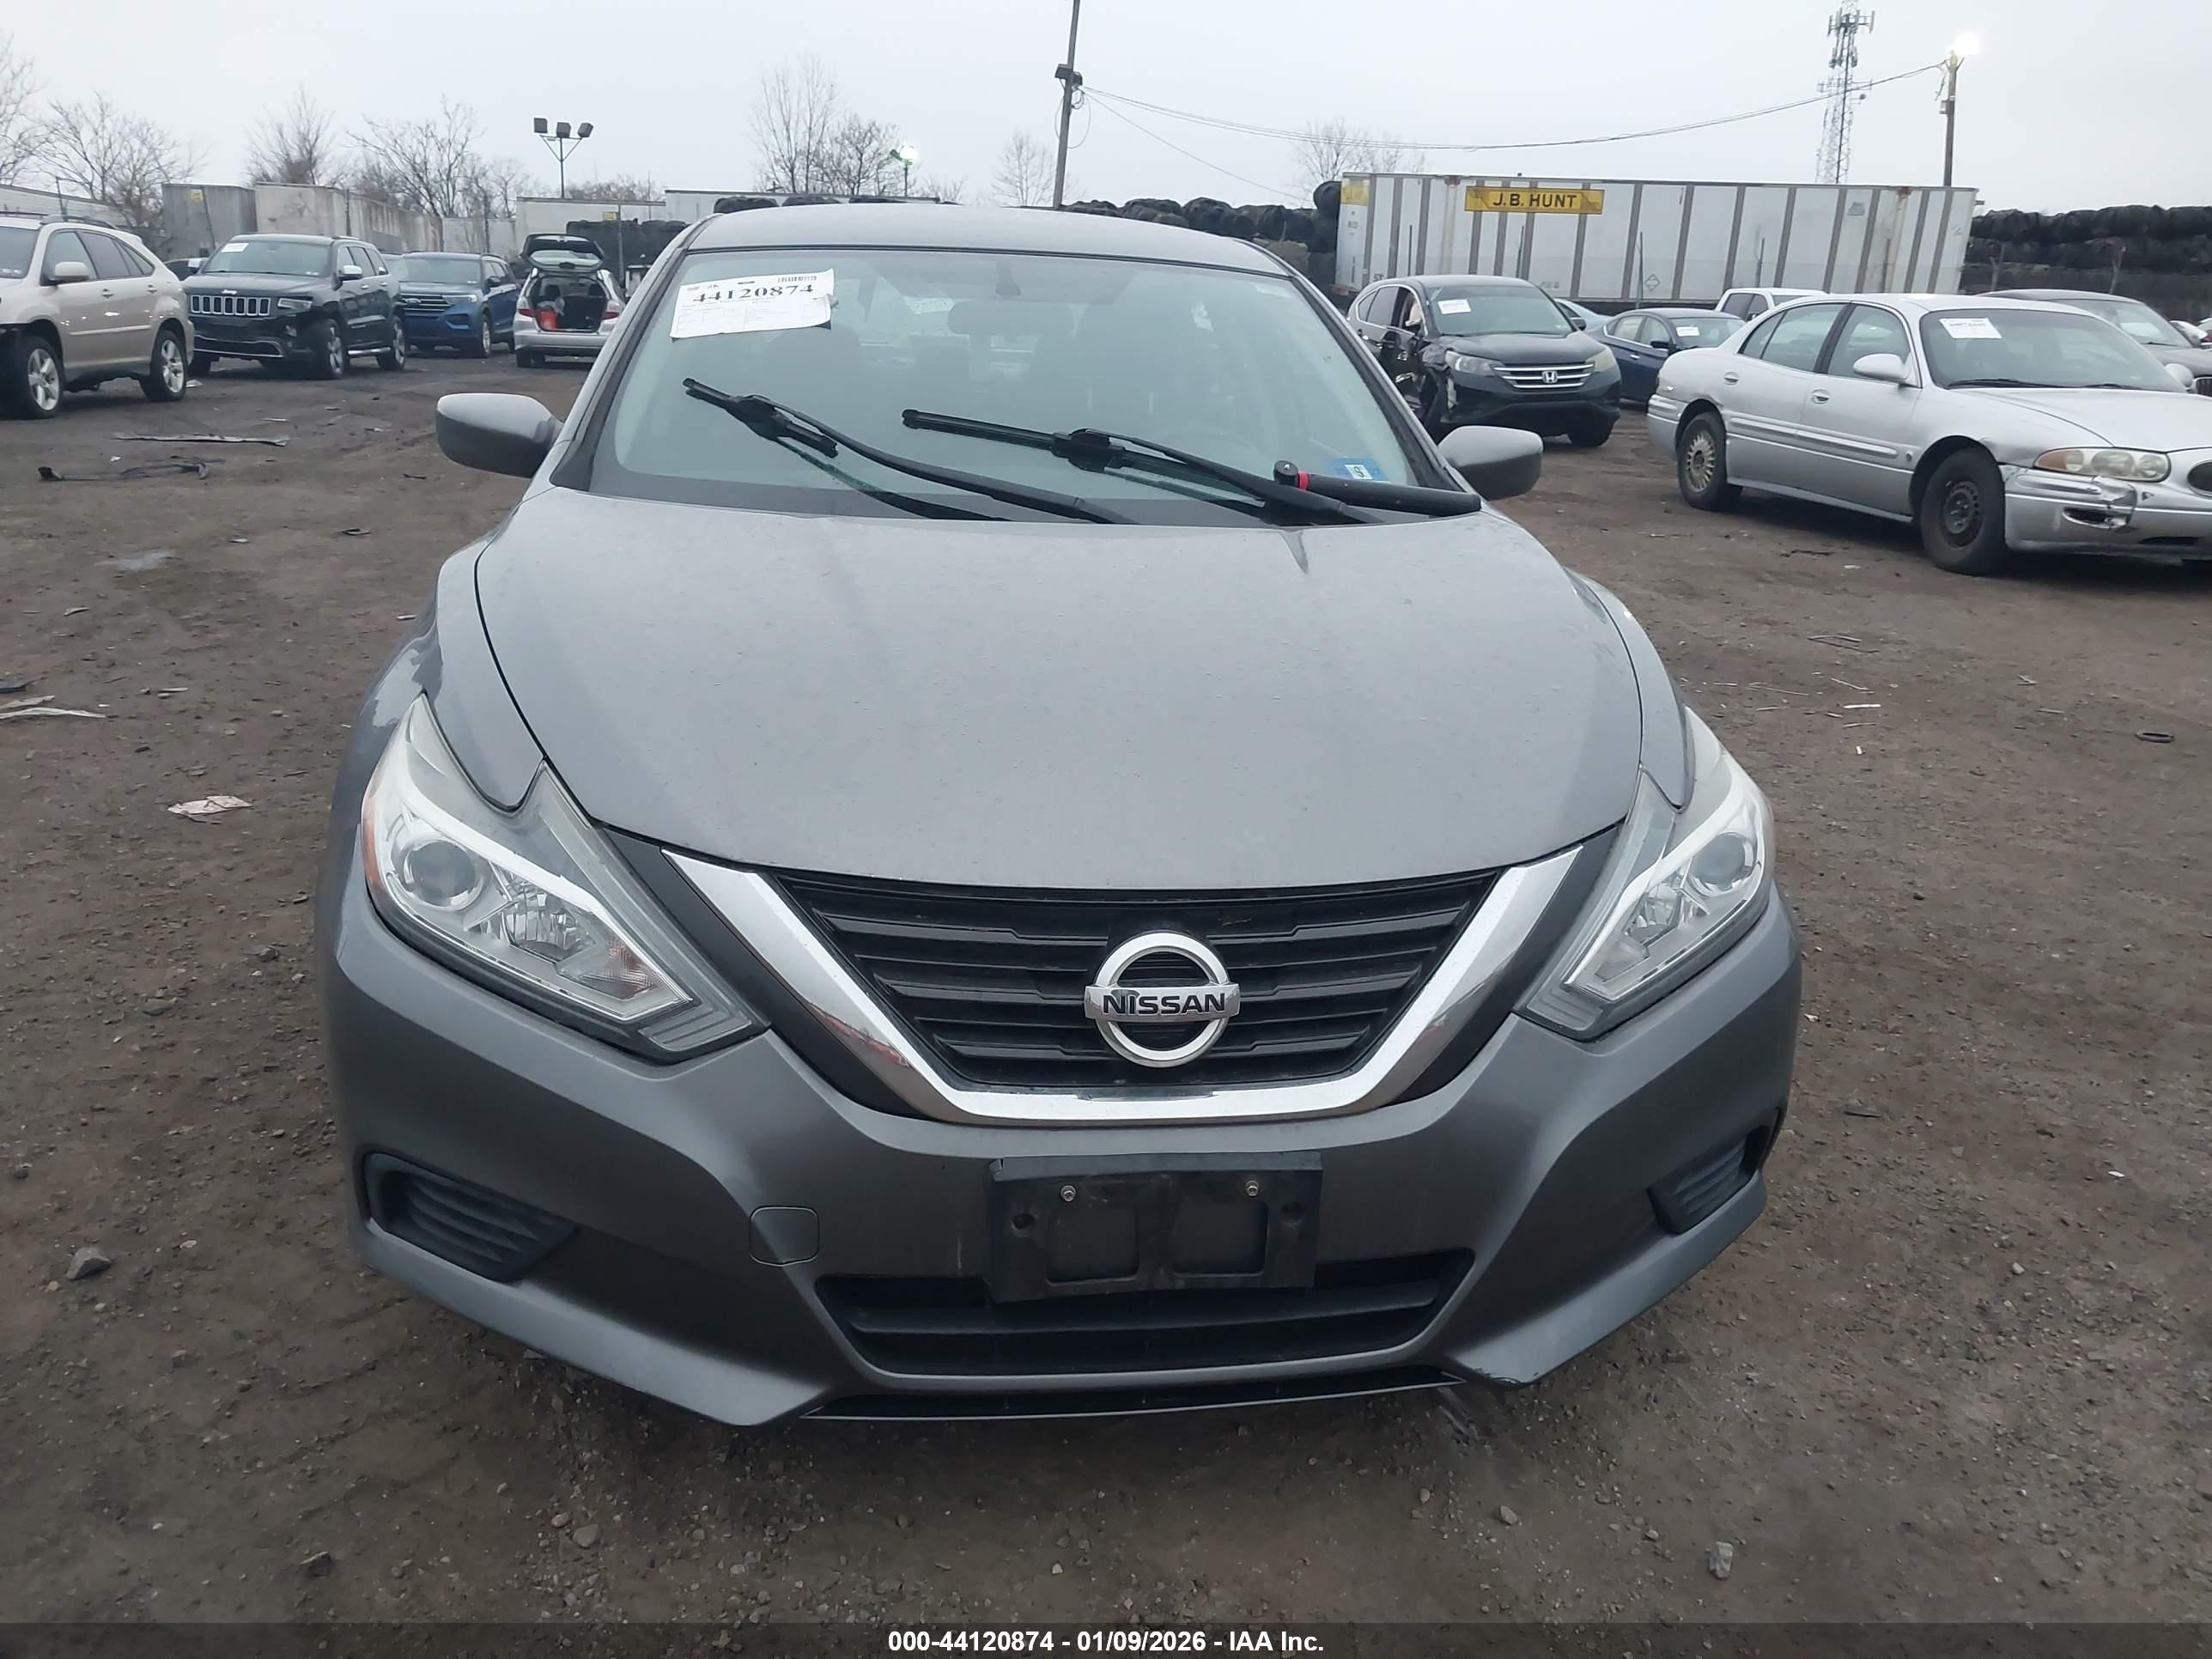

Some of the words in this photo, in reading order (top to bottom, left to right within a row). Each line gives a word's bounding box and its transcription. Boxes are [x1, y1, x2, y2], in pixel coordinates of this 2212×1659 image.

[1492, 193, 1524, 207] J.B.
[1528, 194, 1577, 208] HUNT
[693, 283, 813, 302] 44120874
[1103, 992, 1225, 1015] NISSAN
